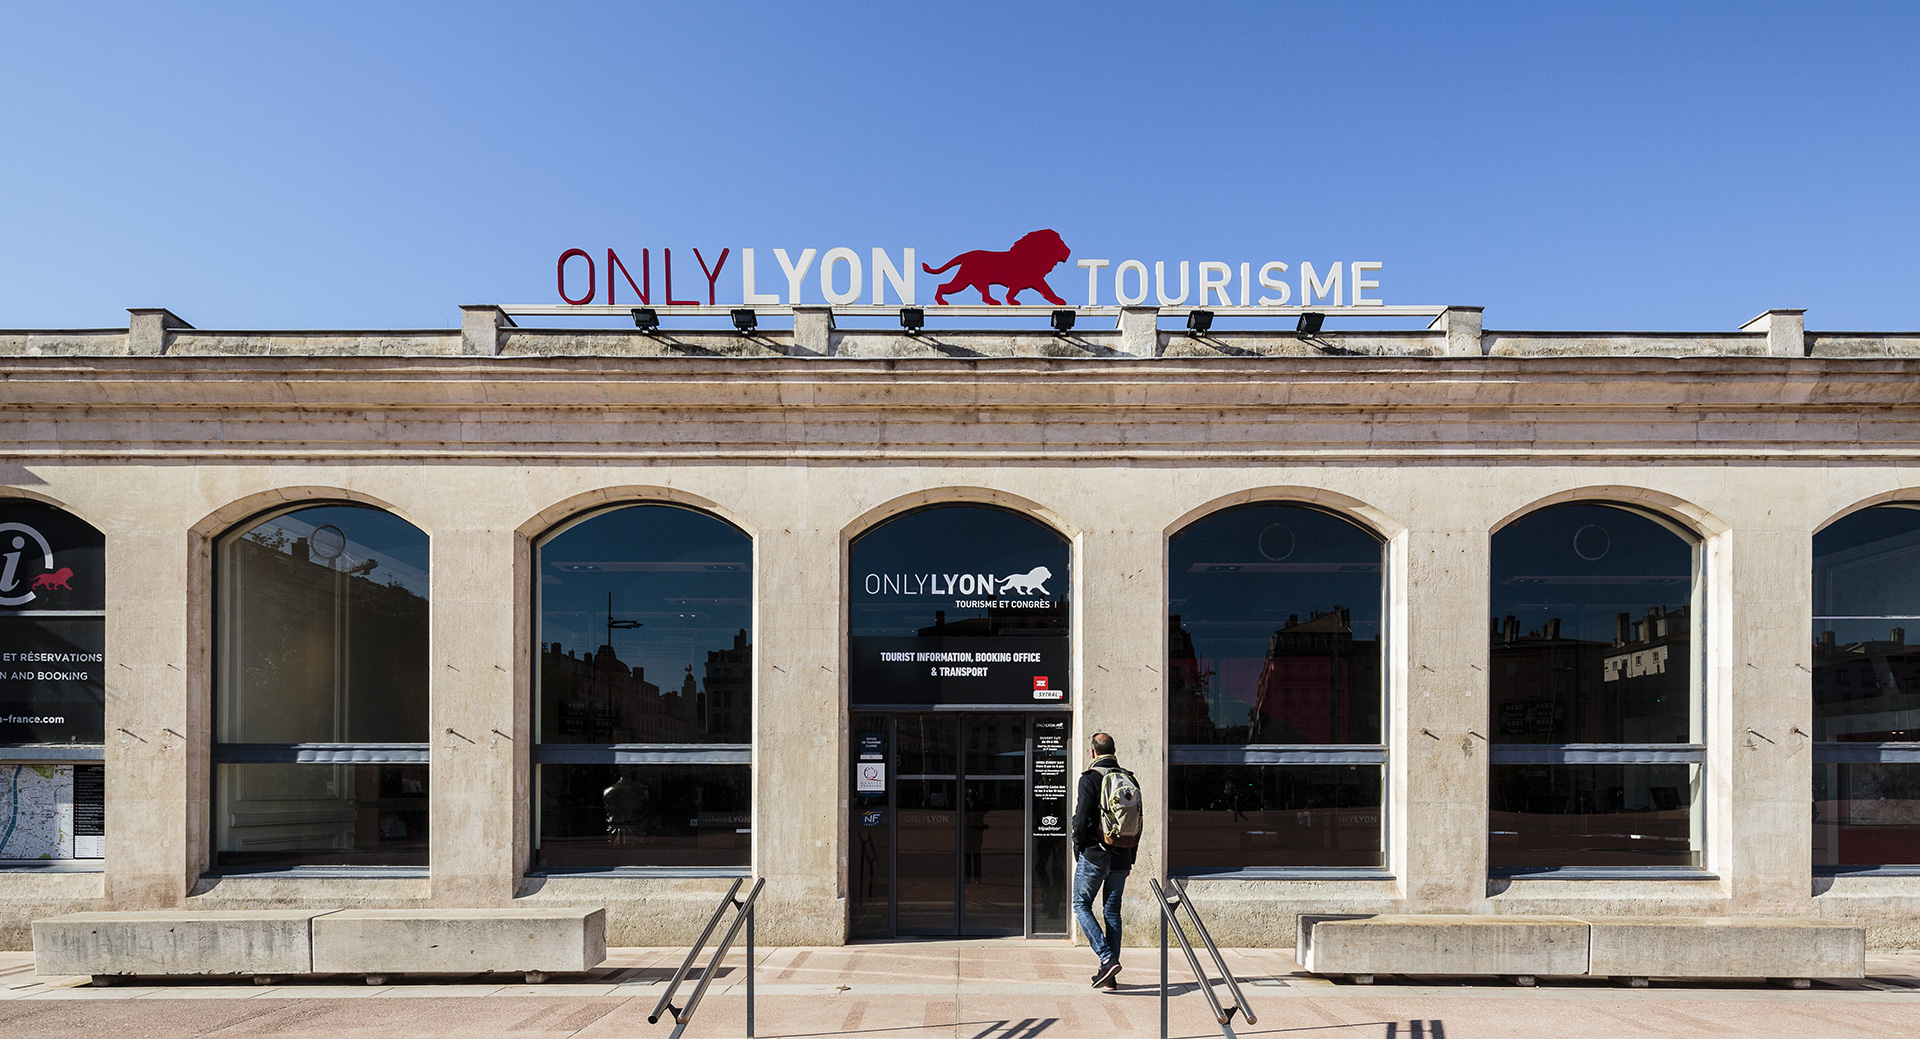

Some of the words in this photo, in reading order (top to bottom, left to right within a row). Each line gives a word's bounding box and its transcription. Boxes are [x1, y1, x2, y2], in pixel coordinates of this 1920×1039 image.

[1077, 259, 1383, 306] TOURISME
[955, 600, 997, 608] TOURISME
[999, 600, 1009, 608] ET
[1011, 599, 1050, 608] CONGRÈS
[3, 653, 17, 661] ET
[20, 651, 103, 662] RÉSERVATIONS
[880, 652, 915, 662] TOURIST
[916, 652, 974, 663] INFORMATION,
[975, 652, 1012, 662] BOOKING
[1013, 652, 1041, 662] OFFICE
[11, 672, 35, 680] AND
[37, 671, 88, 681] BOOKING
[931, 667, 938, 676] &
[939, 667, 988, 677] TRANSPORT
[864, 814, 880, 822] NF
